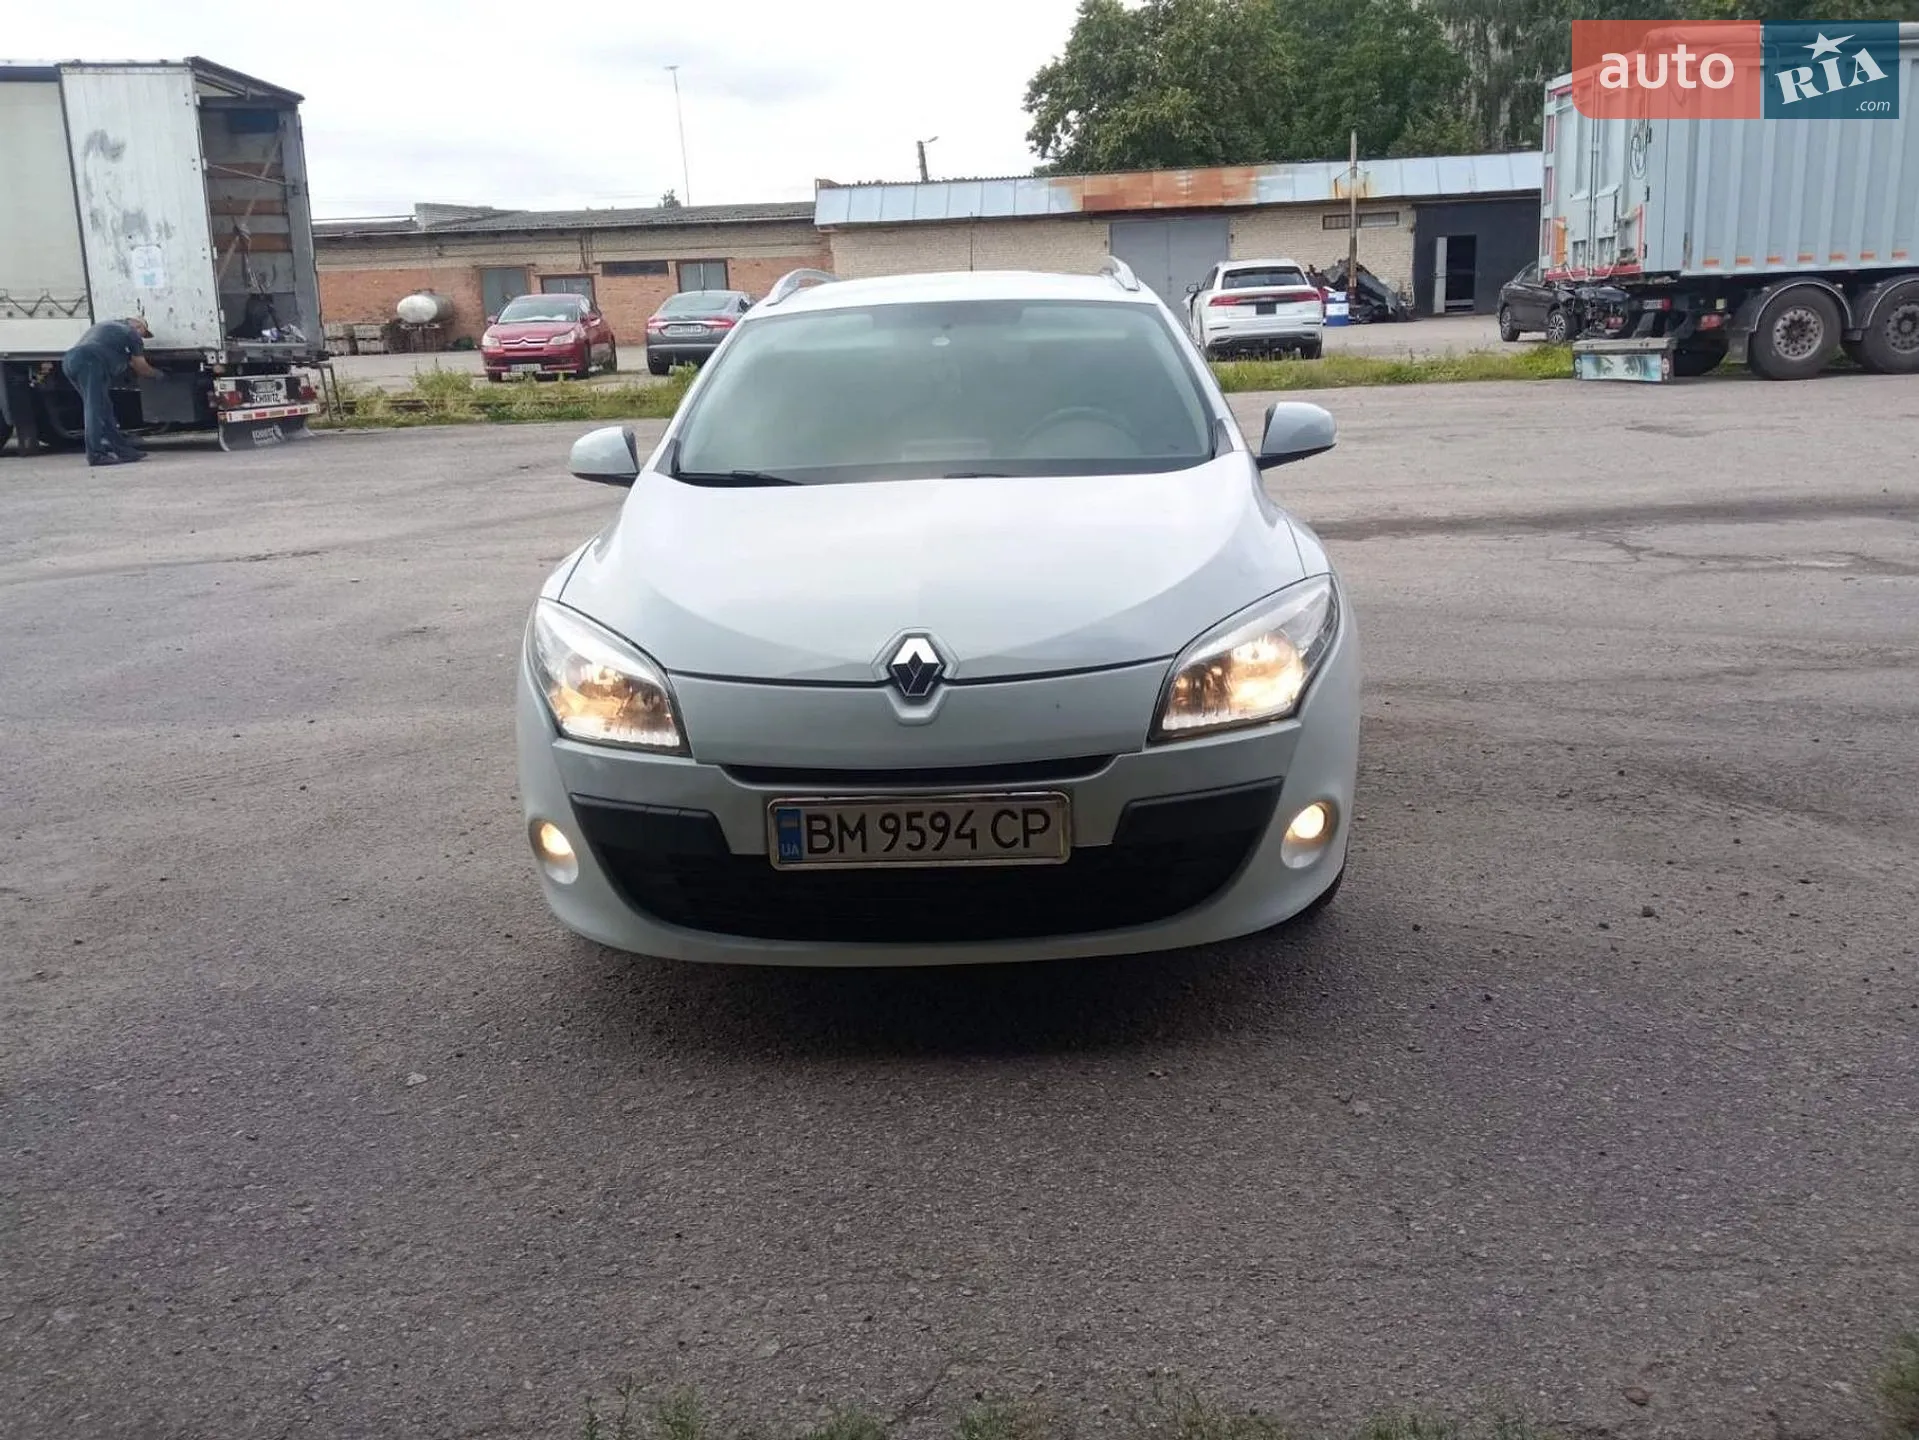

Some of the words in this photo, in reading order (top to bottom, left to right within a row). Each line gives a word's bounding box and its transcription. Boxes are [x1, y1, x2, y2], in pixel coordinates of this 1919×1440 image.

[806, 812, 868, 855] BM
[879, 809, 977, 853] 9594
[990, 807, 1051, 849] CP
[780, 842, 800, 856] UA
